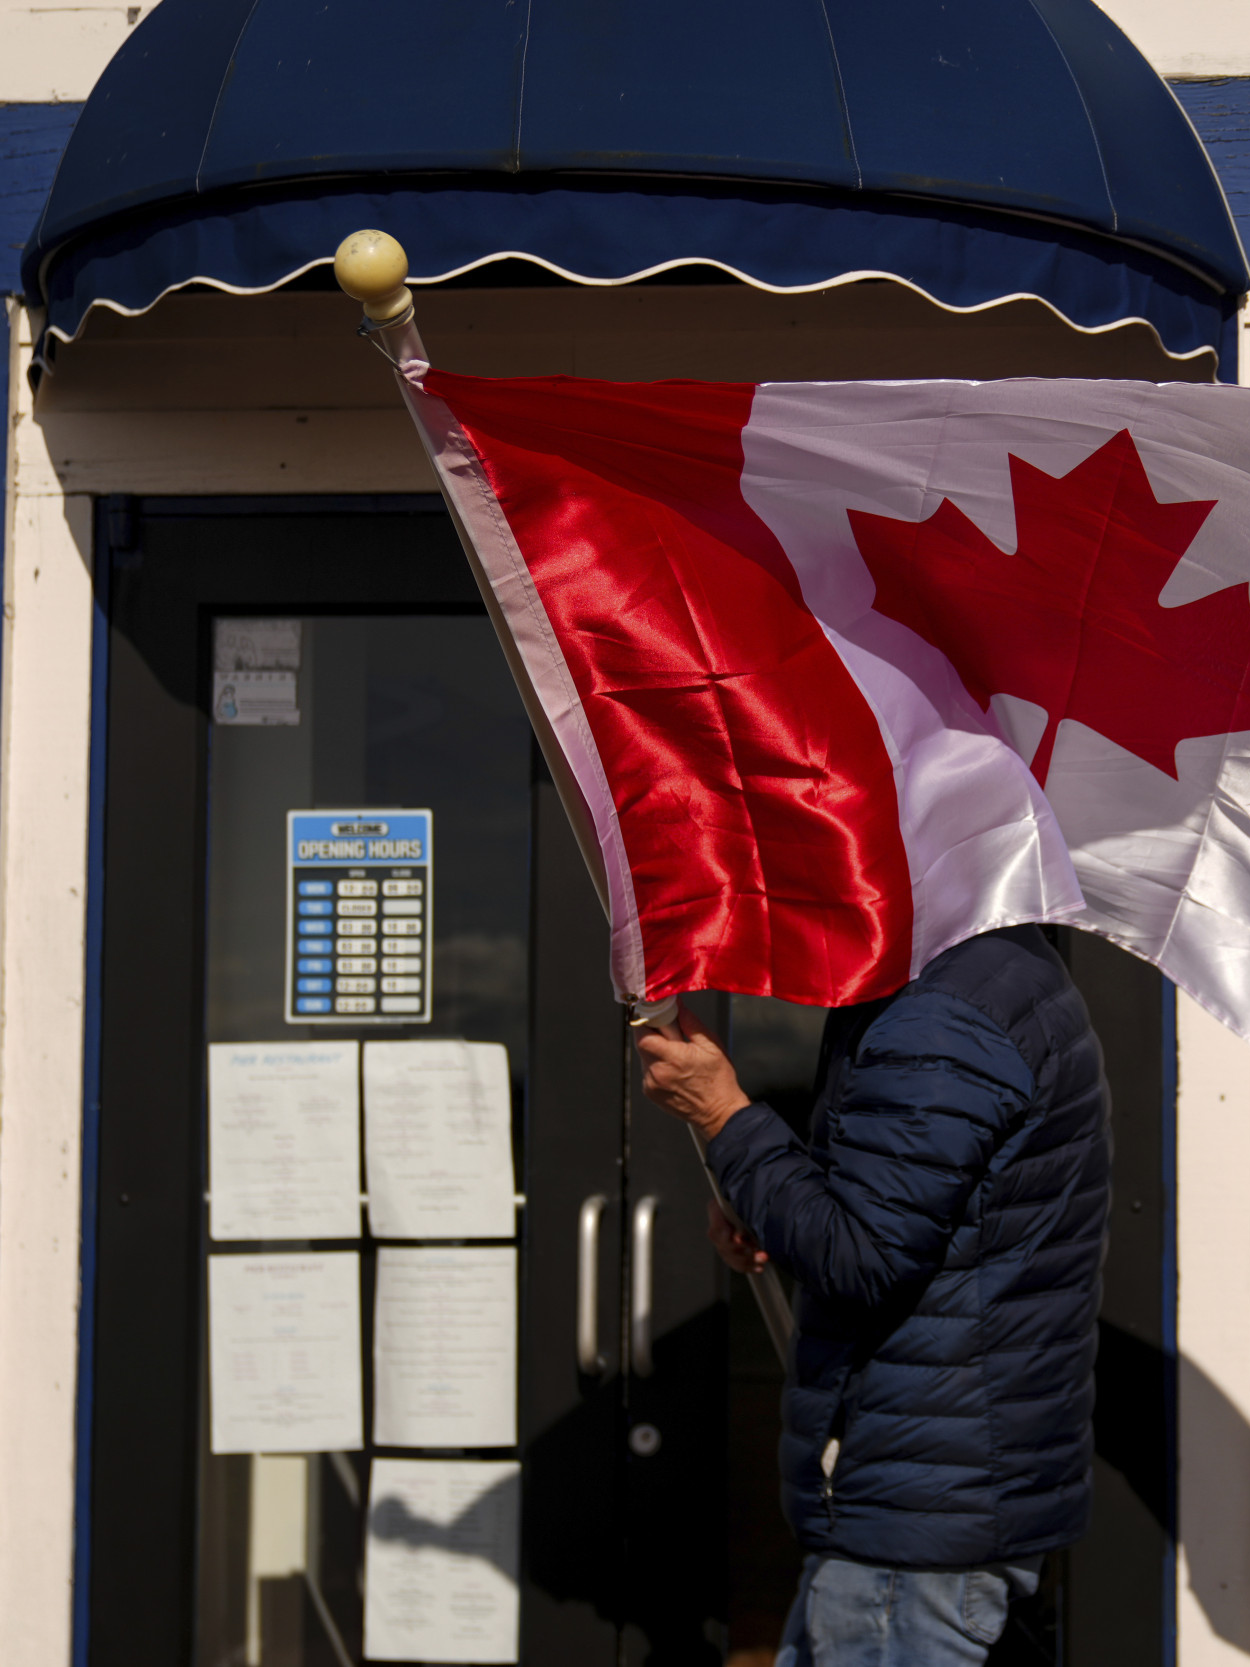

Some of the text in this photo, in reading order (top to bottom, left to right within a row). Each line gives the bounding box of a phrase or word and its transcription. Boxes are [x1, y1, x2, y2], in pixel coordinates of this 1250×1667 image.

[337, 823, 383, 835] WELCOME
[298, 838, 422, 860] OPENING HOURS
